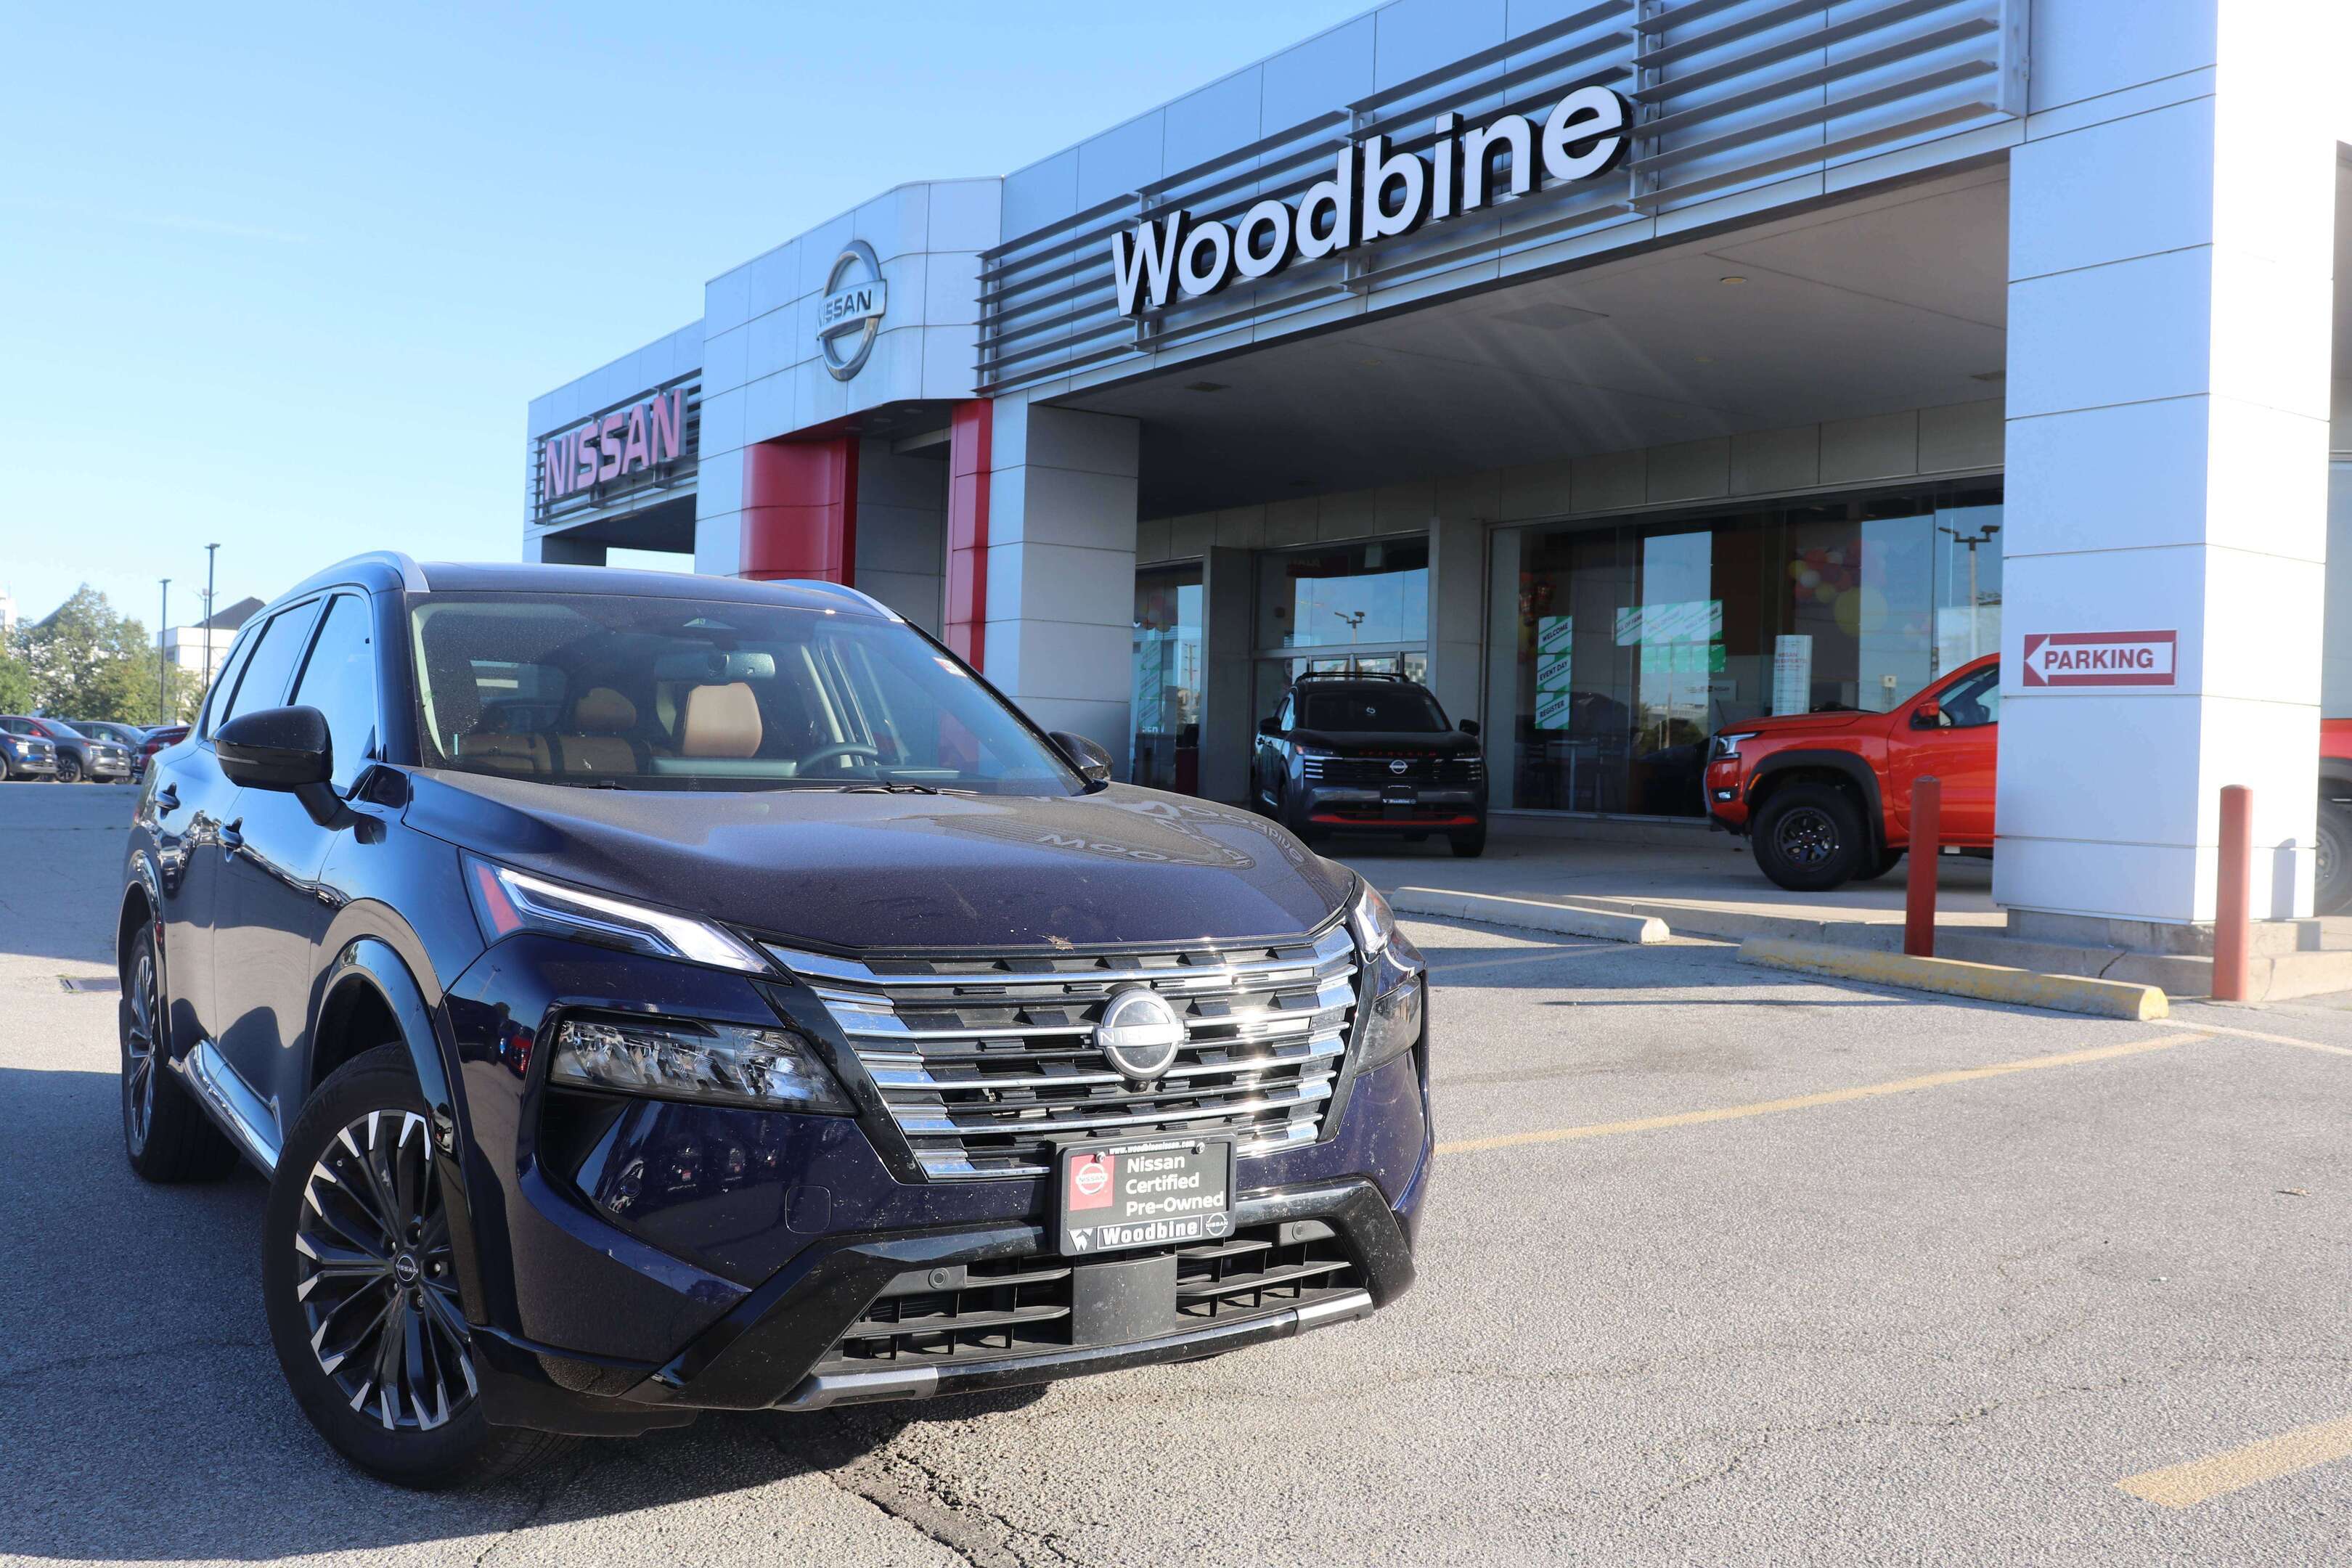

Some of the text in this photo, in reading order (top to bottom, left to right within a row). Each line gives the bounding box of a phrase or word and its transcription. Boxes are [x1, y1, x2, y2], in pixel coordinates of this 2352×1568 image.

[1111, 85, 1630, 318] Woodbine
[819, 289, 872, 327] NISSAN
[544, 388, 685, 501] NISSAN
[1542, 622, 1569, 642] WELCOME
[2044, 648, 2155, 669] PARKING
[1539, 661, 1568, 681] EVENT DAY
[1540, 700, 1564, 718] REGISTER
[1127, 1156, 1185, 1173] Nissan
[1126, 1172, 1199, 1194] Certified
[1127, 1191, 1224, 1216] Pre-Owned
[1103, 1220, 1198, 1245] Woodbine
